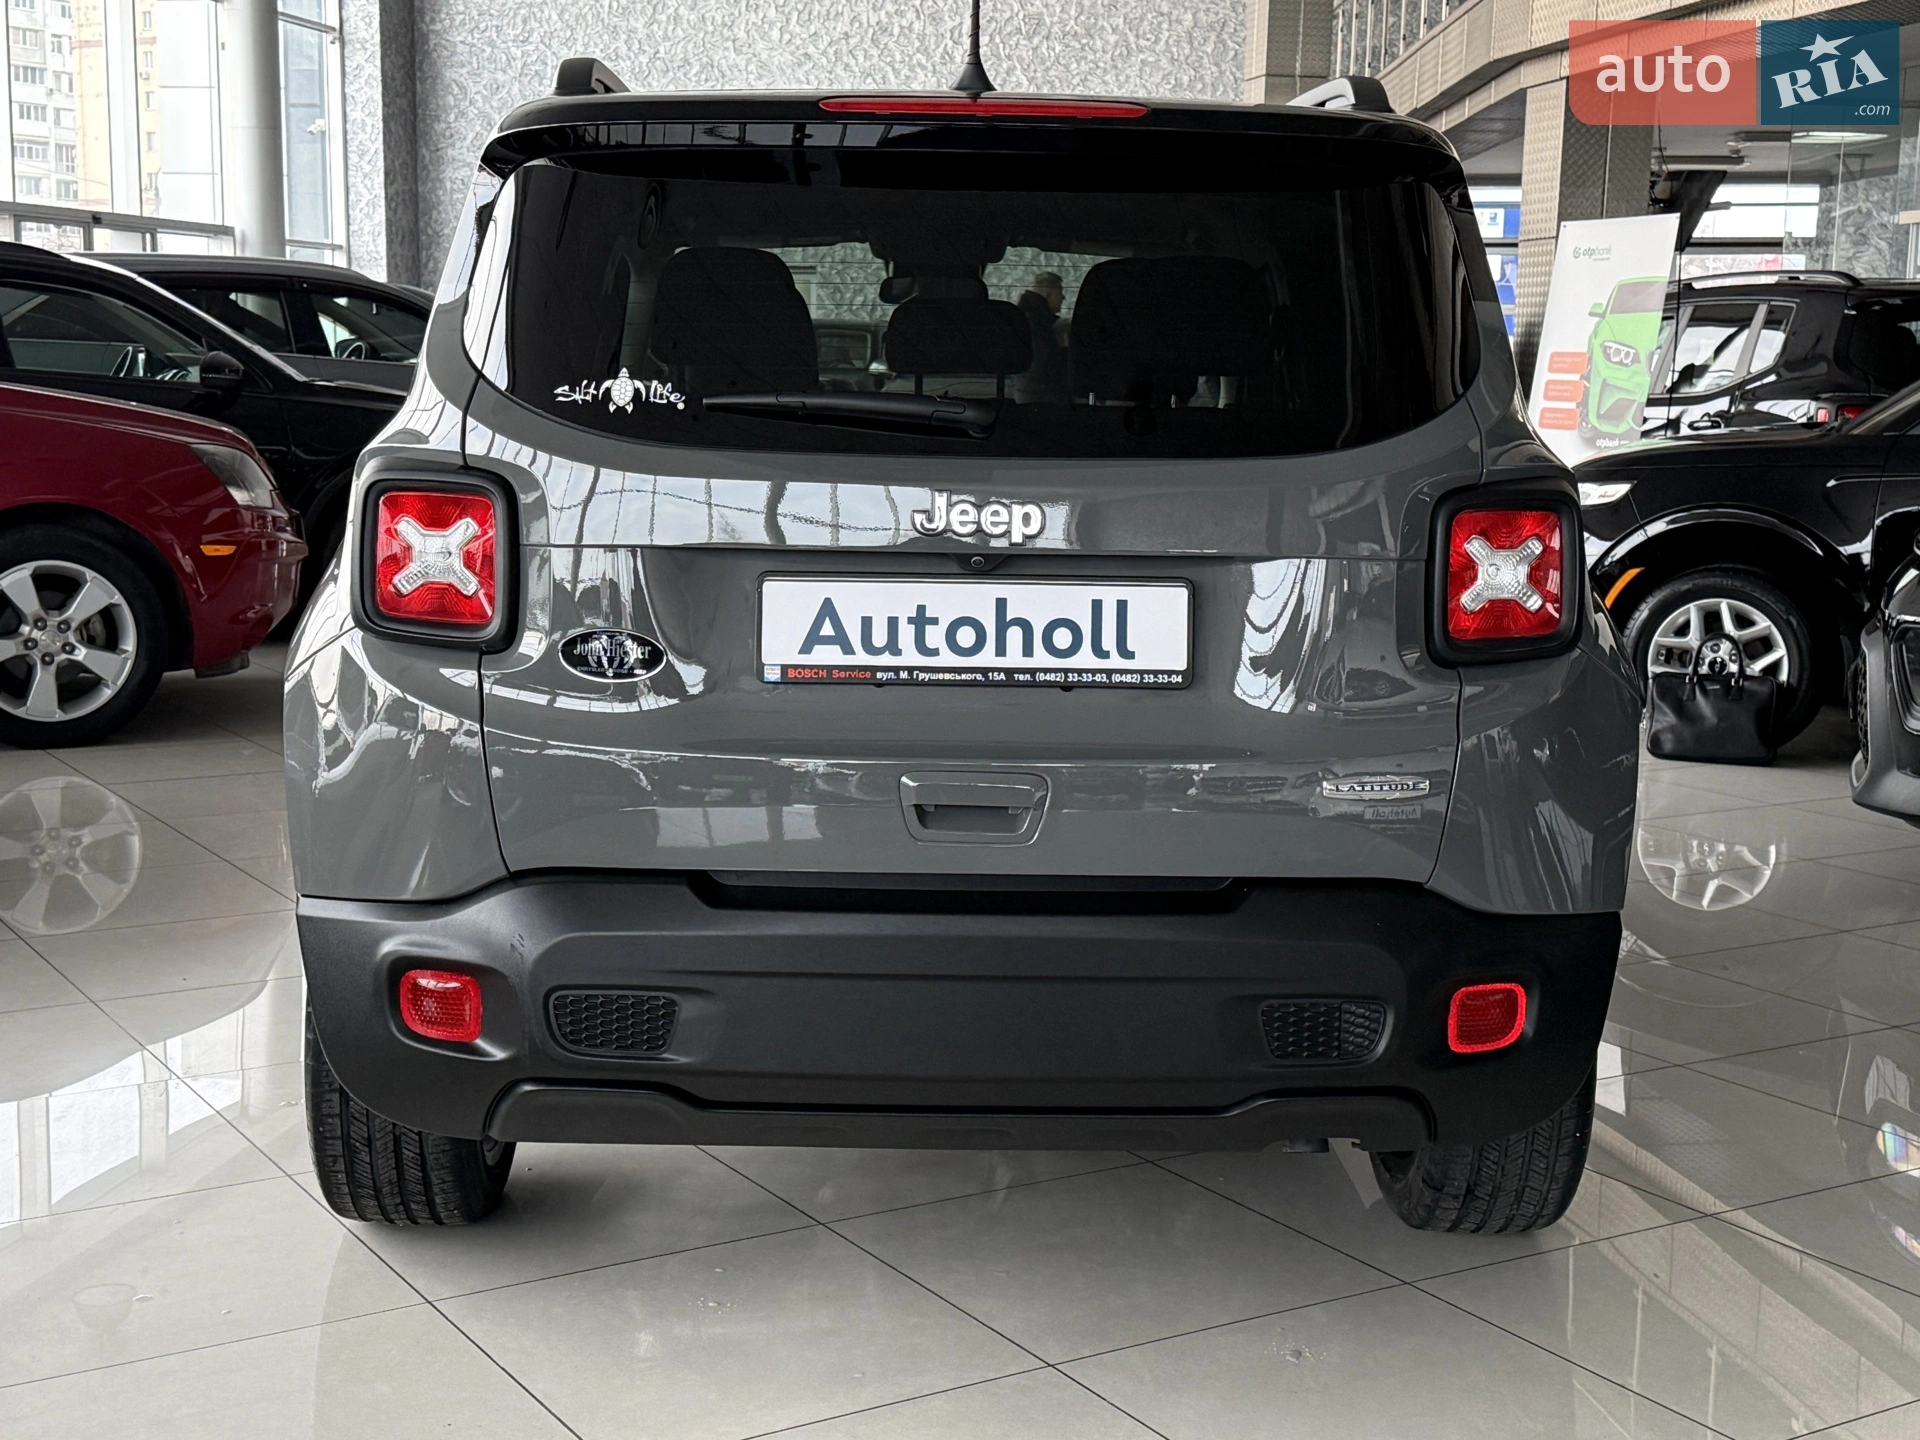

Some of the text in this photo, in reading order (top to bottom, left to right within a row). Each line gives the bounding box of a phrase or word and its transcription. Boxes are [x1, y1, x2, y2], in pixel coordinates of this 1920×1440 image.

[911, 490, 1046, 546] Jeep
[797, 596, 1136, 660] Autoholl
[573, 637, 651, 659] John Hiester
[787, 668, 827, 679] BOSCH
[832, 669, 872, 679] Service
[876, 670, 897, 680] вул.
[913, 670, 985, 682] Грушевського,
[1013, 673, 1034, 681] тел.
[1035, 672, 1065, 683] (0482)
[1067, 672, 1110, 684] 33-33-03,
[1111, 673, 1141, 684] (0482)
[1143, 673, 1183, 683] 33-33-04
